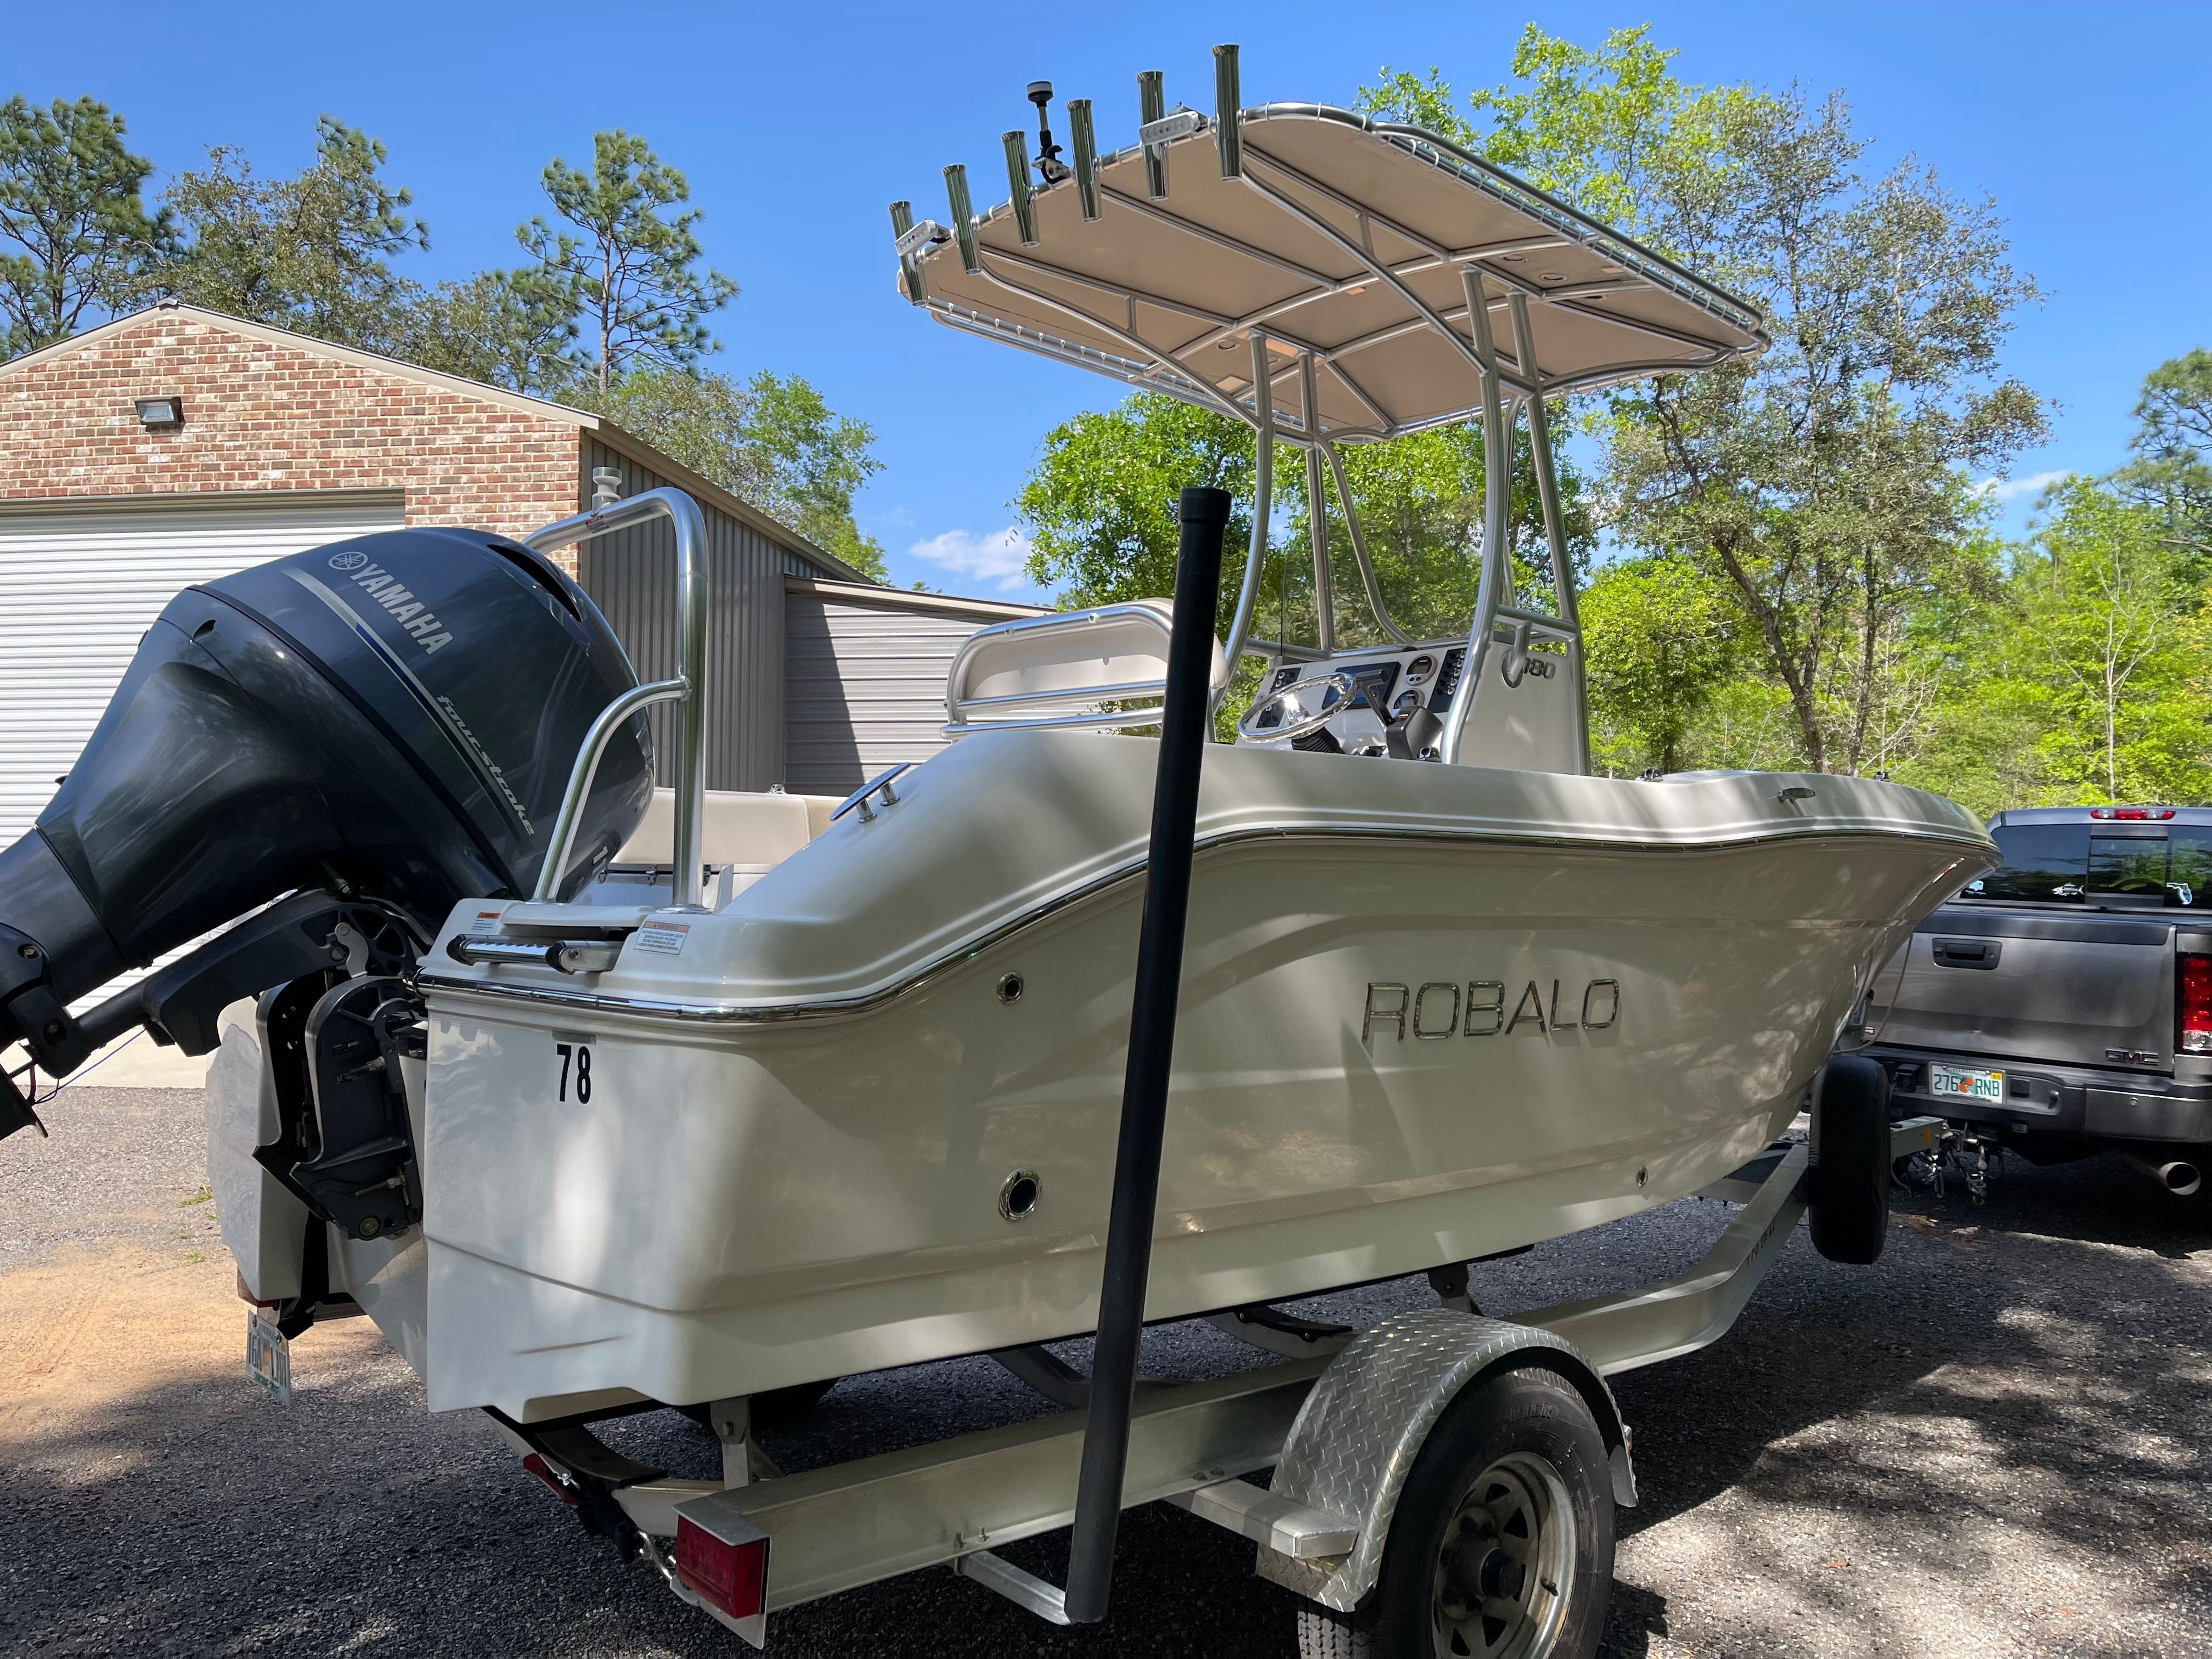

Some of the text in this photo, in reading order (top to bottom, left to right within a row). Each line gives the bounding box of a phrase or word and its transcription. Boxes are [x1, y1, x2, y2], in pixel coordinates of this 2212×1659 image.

[349, 563, 454, 656] YAMAHA
[849, 772, 889, 801] ROBALO
[1361, 978, 1620, 1042] ROBALO
[556, 1043, 591, 1104] 78
[2106, 1047, 2159, 1066] GMC
[1934, 1074, 2000, 1097] 276 RNB
